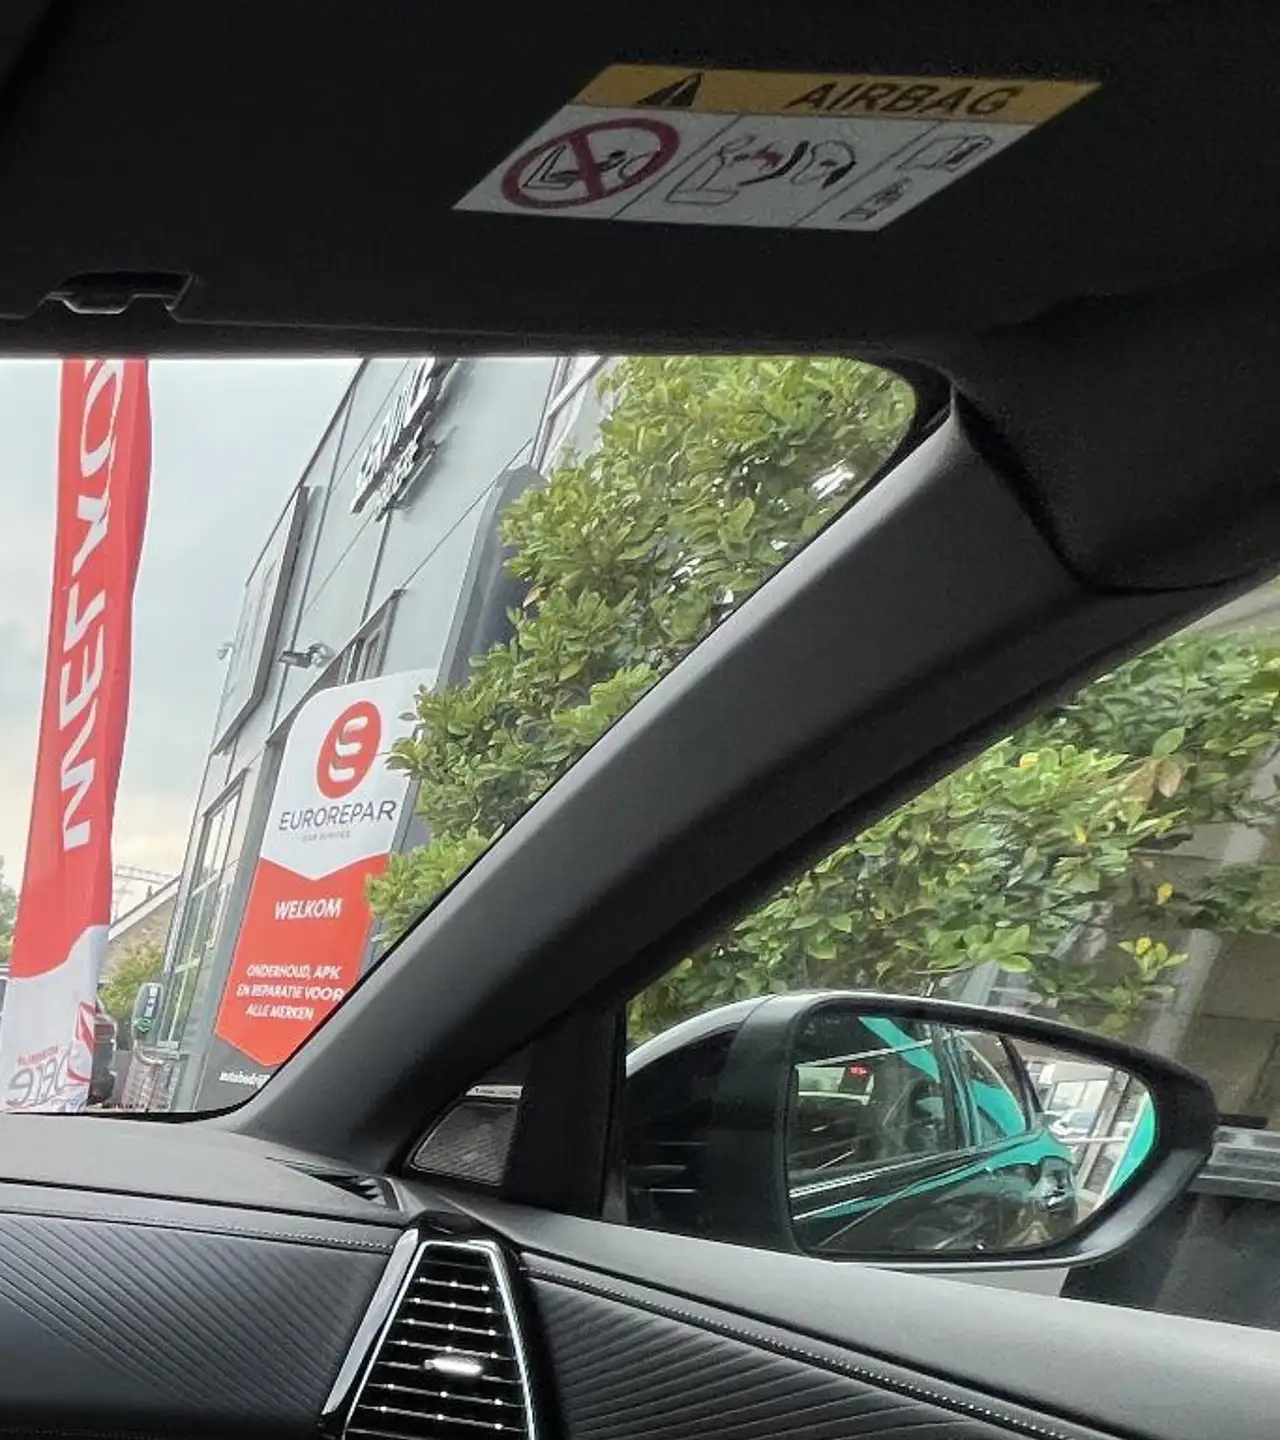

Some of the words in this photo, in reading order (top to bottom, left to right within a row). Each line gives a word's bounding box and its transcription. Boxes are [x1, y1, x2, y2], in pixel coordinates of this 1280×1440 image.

[785, 81, 1017, 114] AIRBAG
[278, 800, 397, 831] EUROREPAR
[274, 898, 344, 920] WELKOM
[313, 965, 343, 980] APK
[305, 986, 345, 1002] VOOR
